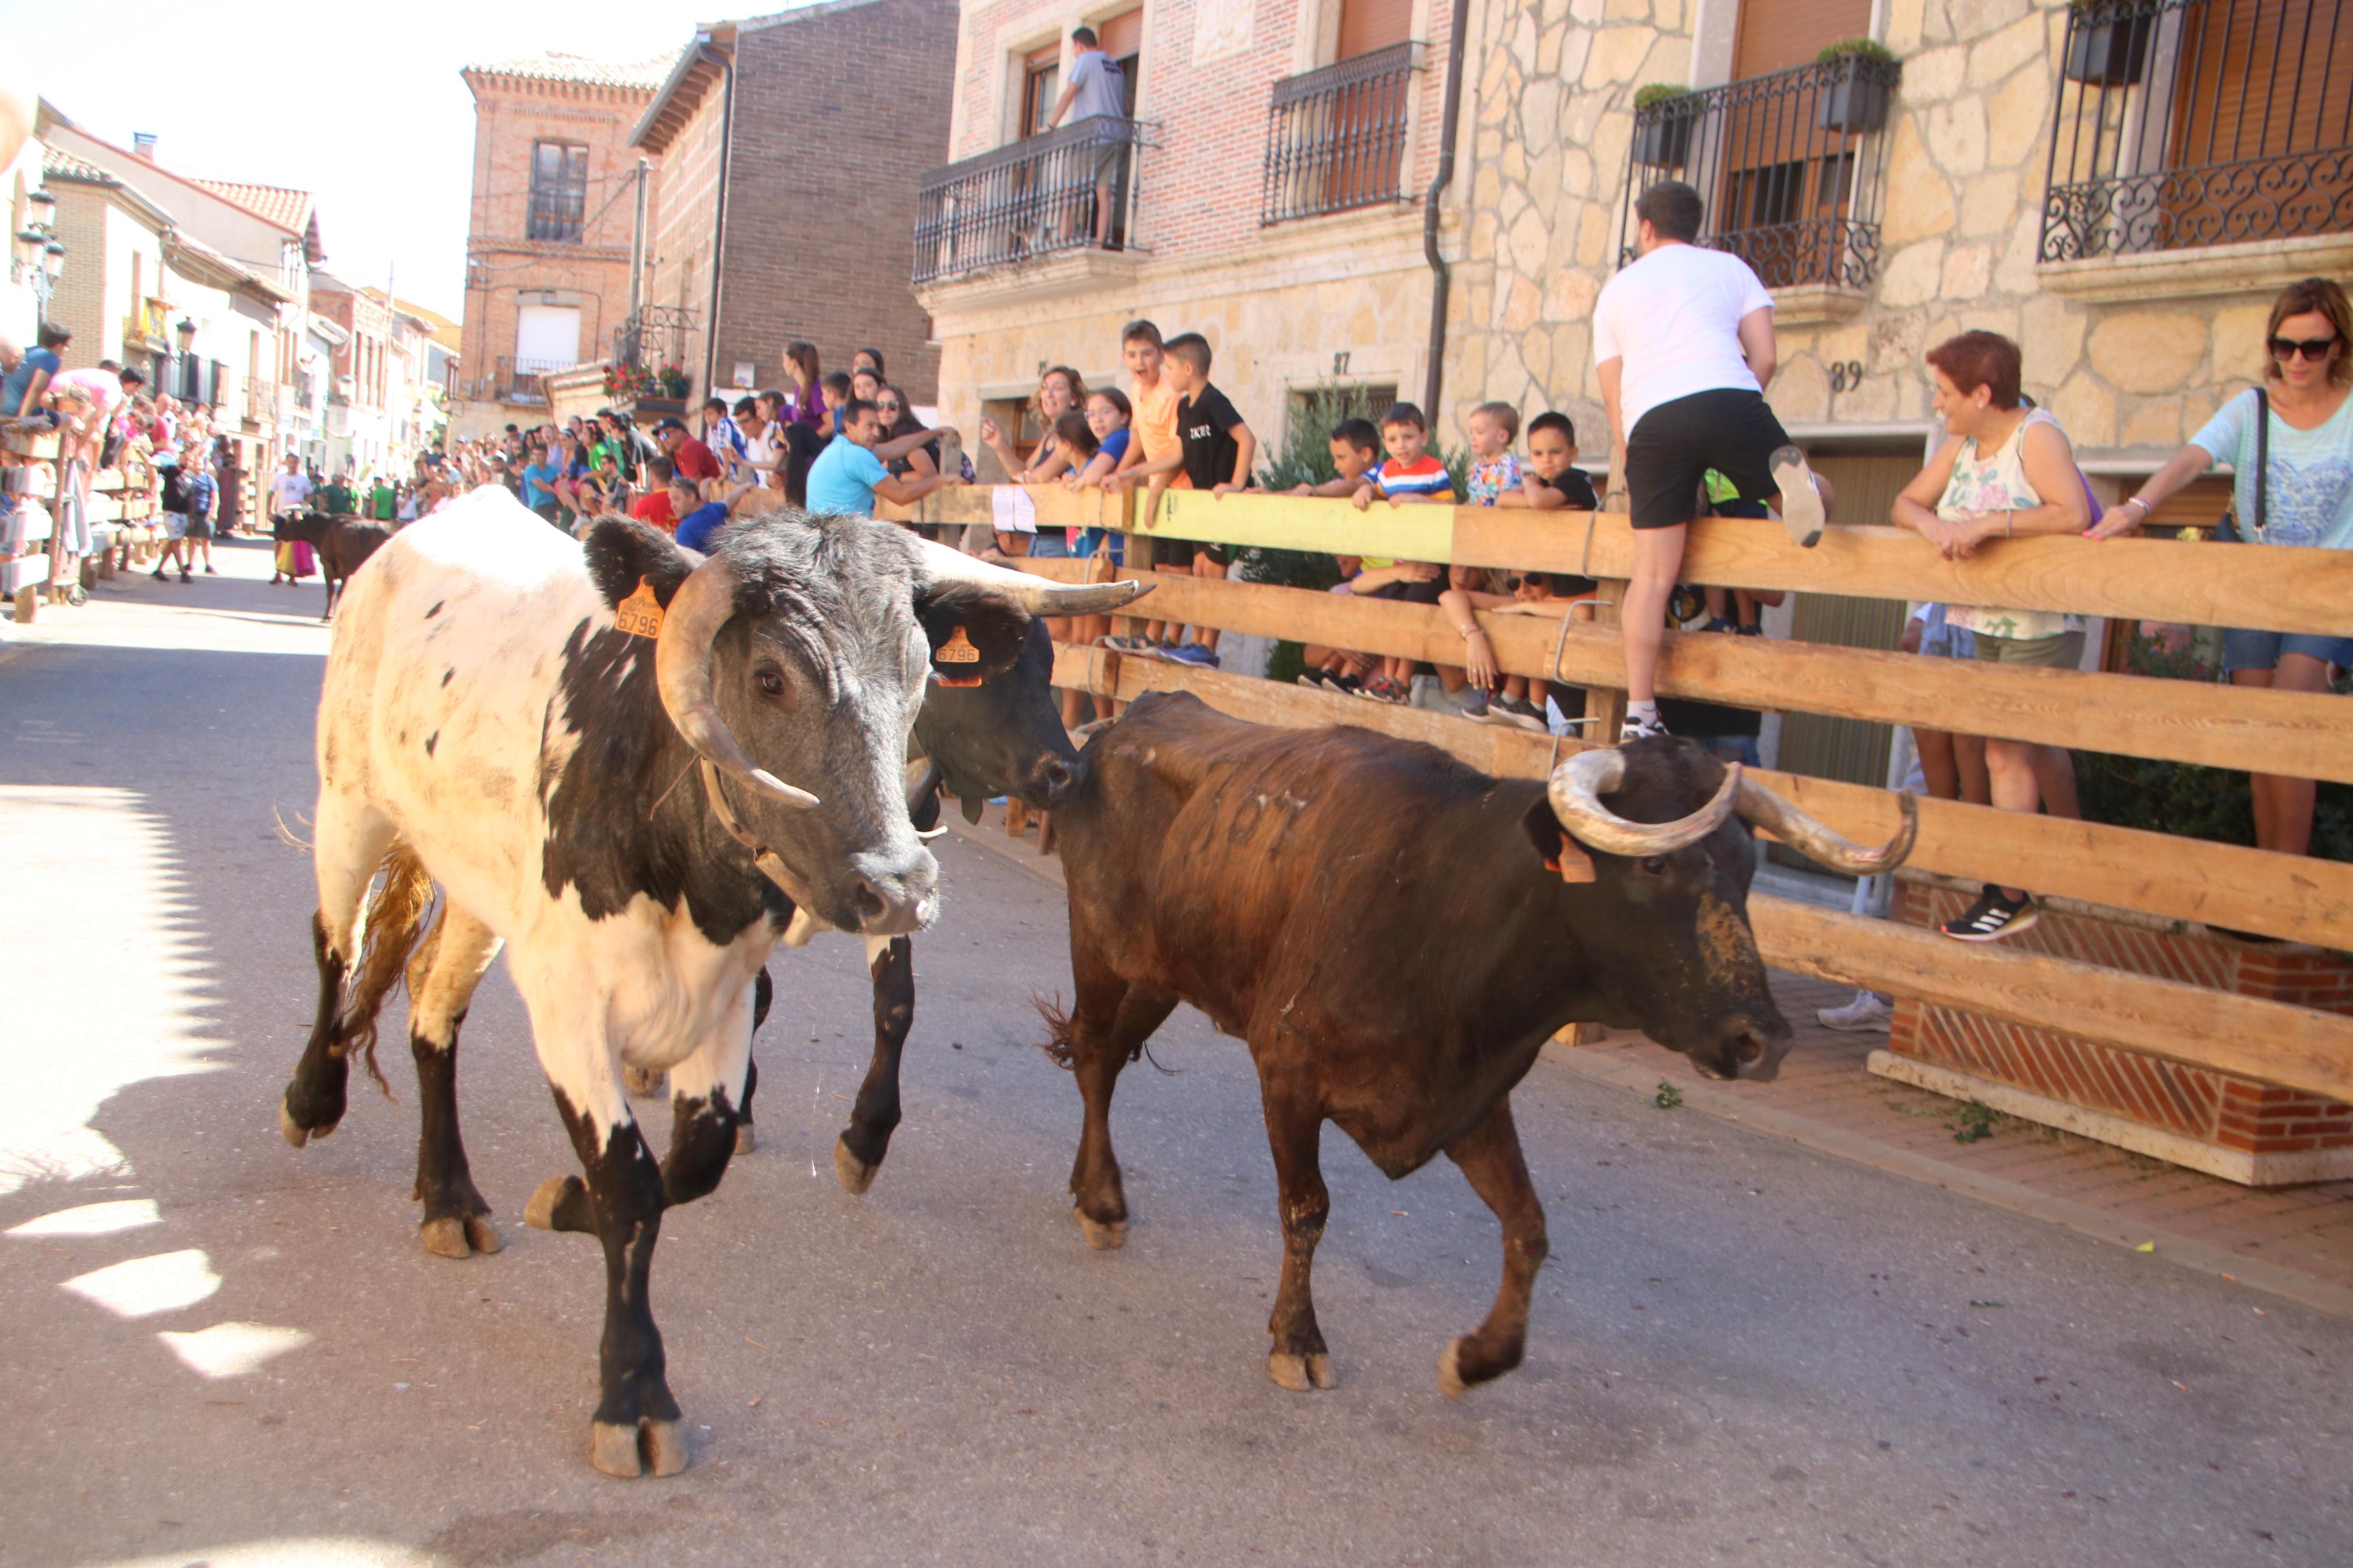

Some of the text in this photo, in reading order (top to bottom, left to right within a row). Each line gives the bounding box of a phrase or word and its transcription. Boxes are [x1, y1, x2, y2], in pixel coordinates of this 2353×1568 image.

[1832, 361, 1862, 393] 89
[619, 611, 658, 636] 6796
[938, 649, 975, 661] 6796
